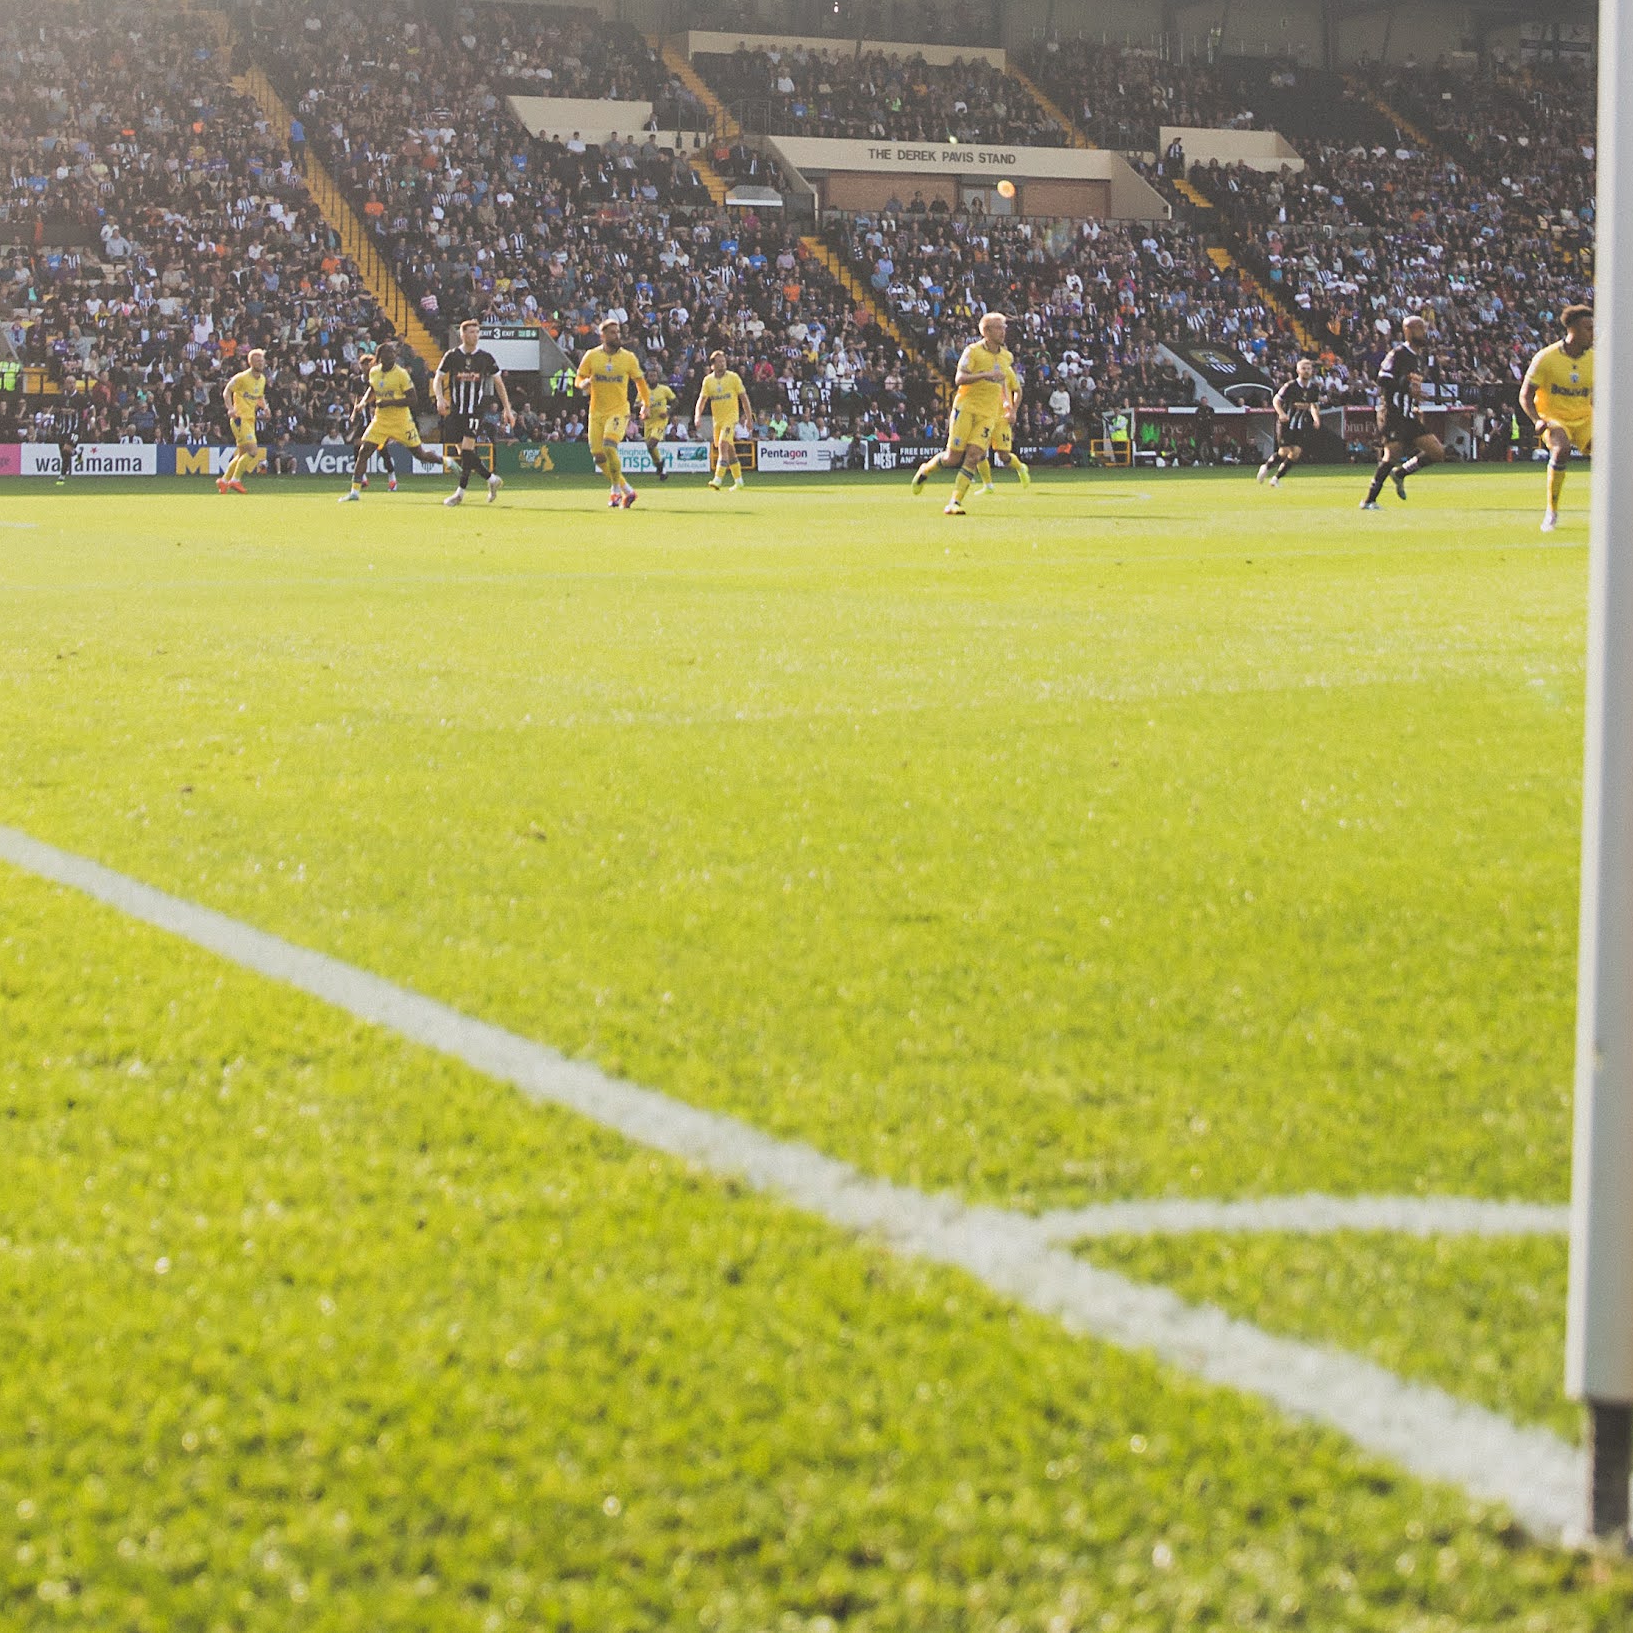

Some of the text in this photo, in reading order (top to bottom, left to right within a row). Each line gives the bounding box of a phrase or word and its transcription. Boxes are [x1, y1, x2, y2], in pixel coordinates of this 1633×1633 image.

[868, 148, 1016, 165] THE DEREK PAVIS STAND
[493, 327, 501, 339] 3
[879, 442, 891, 453] THE
[900, 448, 918, 456] FREE
[760, 448, 808, 460] Pentagon
[36, 457, 142, 472] waamama
[874, 453, 896, 469] NEST
